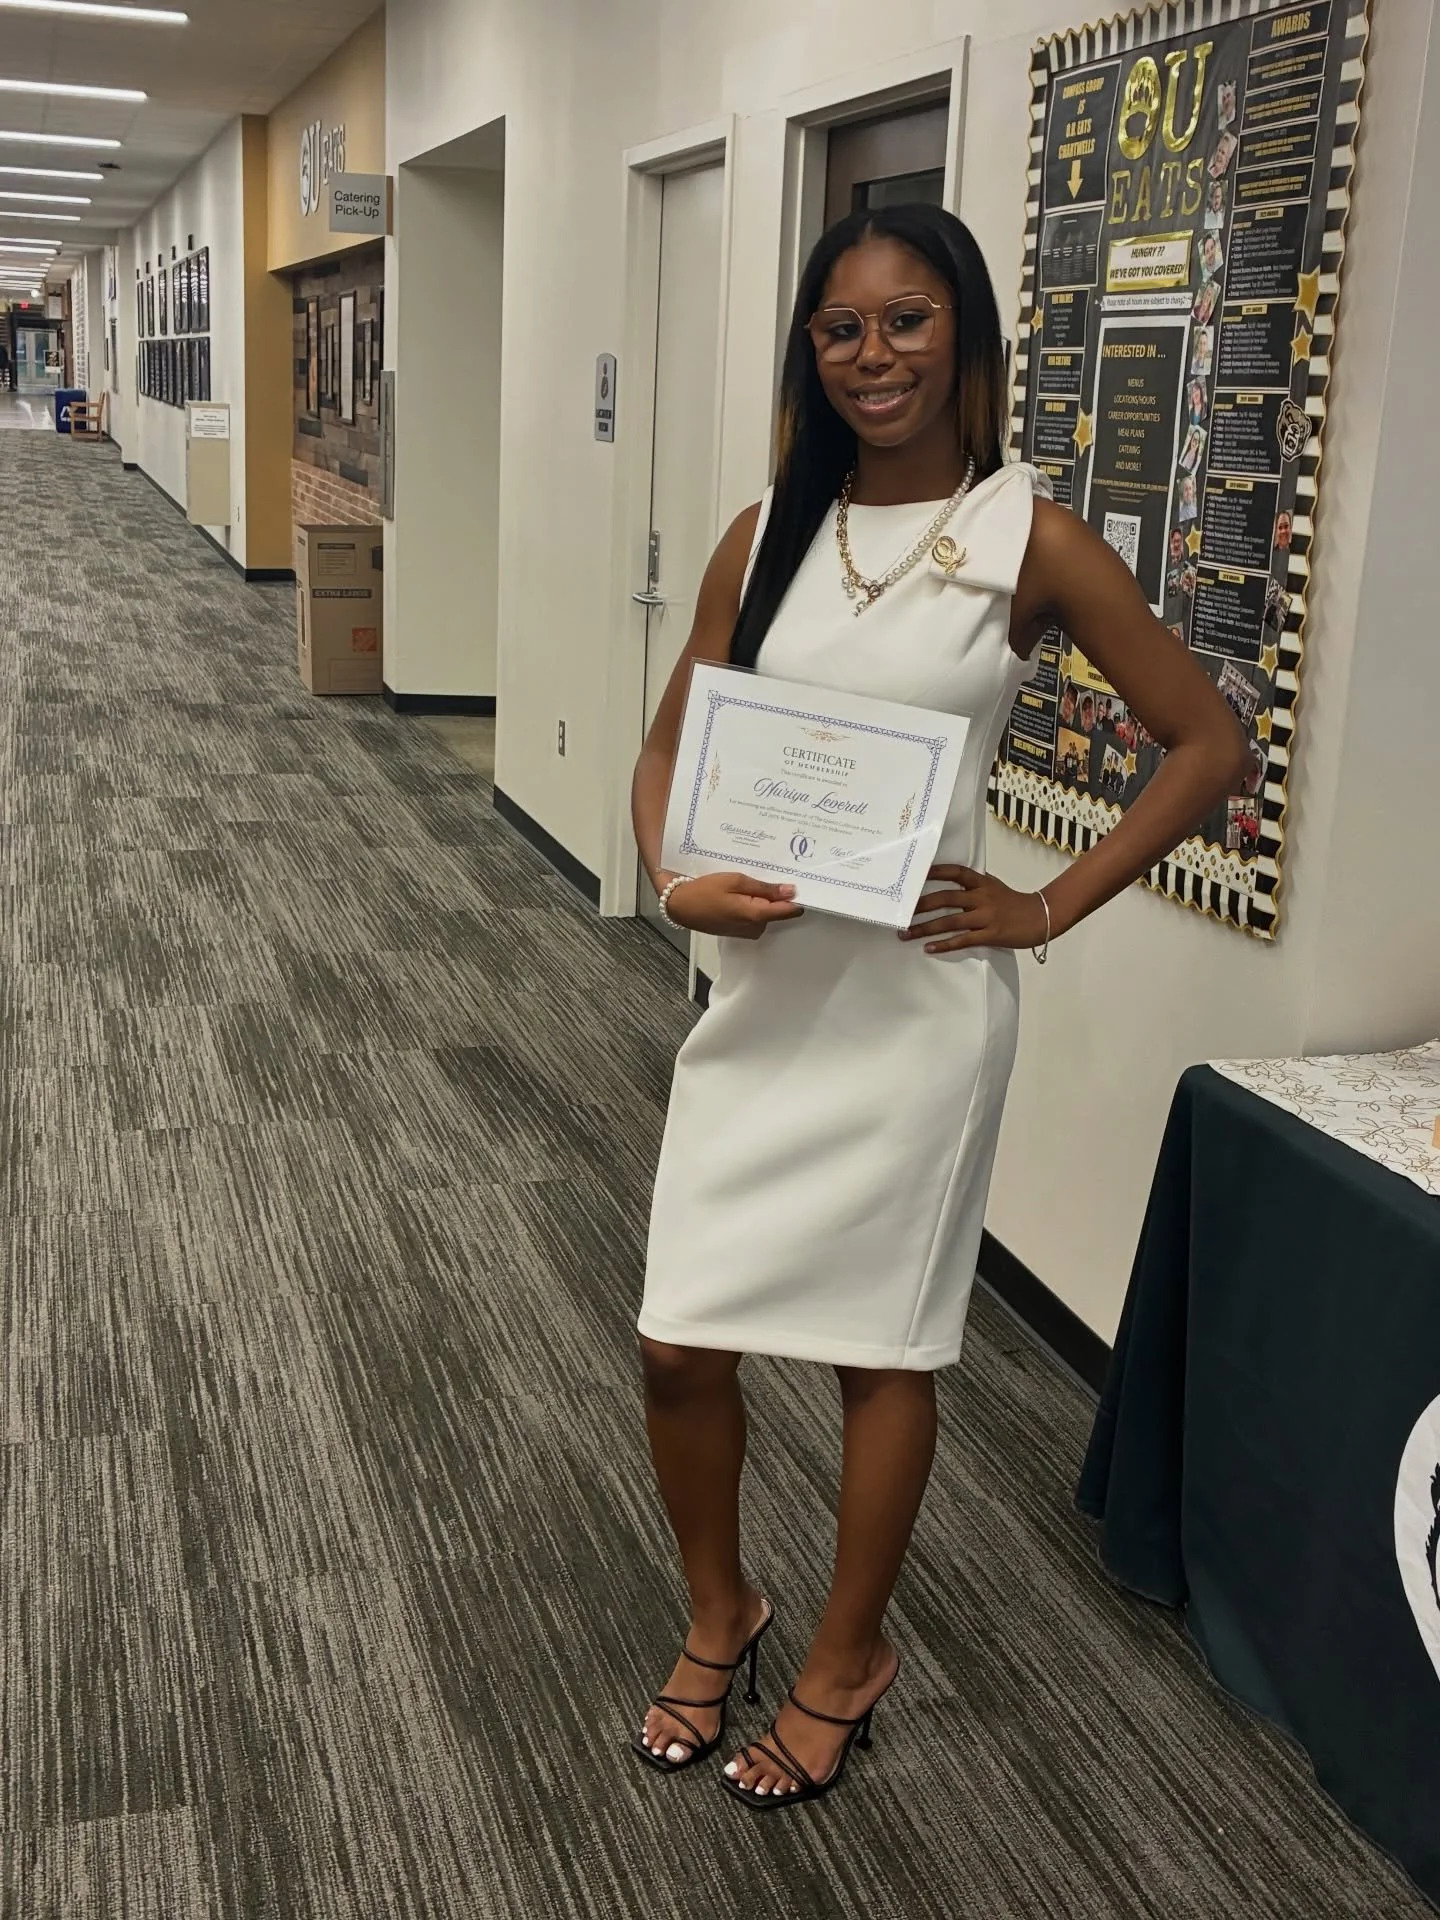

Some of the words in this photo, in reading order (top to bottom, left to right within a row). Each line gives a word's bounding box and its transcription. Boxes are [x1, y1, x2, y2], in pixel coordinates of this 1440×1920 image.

[1271, 11, 1311, 38] AWARDS
[334, 190, 380, 205] Catering
[1108, 157, 1204, 225] EATS
[335, 204, 379, 218] Pick-Up
[1131, 246, 1157, 258] HUNGRY
[1157, 246, 1166, 256] ??
[1110, 268, 1127, 279] WE'VE
[1128, 267, 1140, 278] GOT
[1141, 266, 1154, 277] YOU
[1102, 344, 1145, 358] INTERESTED
[1146, 344, 1157, 358] IN
[1127, 378, 1144, 388] MENUS
[1108, 411, 1123, 420] CAREER
[1123, 412, 1161, 422] OPPORTUNITIES
[1118, 428, 1130, 438] MEAL
[1130, 429, 1145, 439] PLANS
[1118, 445, 1141, 455] CATERING
[1115, 461, 1125, 470] AND
[1125, 461, 1142, 472] MORE!
[783, 746, 857, 770] CERTIFICATE
[798, 762, 849, 777] MEMBERSHIP
[811, 791, 869, 815] Leverett
[790, 834, 816, 862] QC
